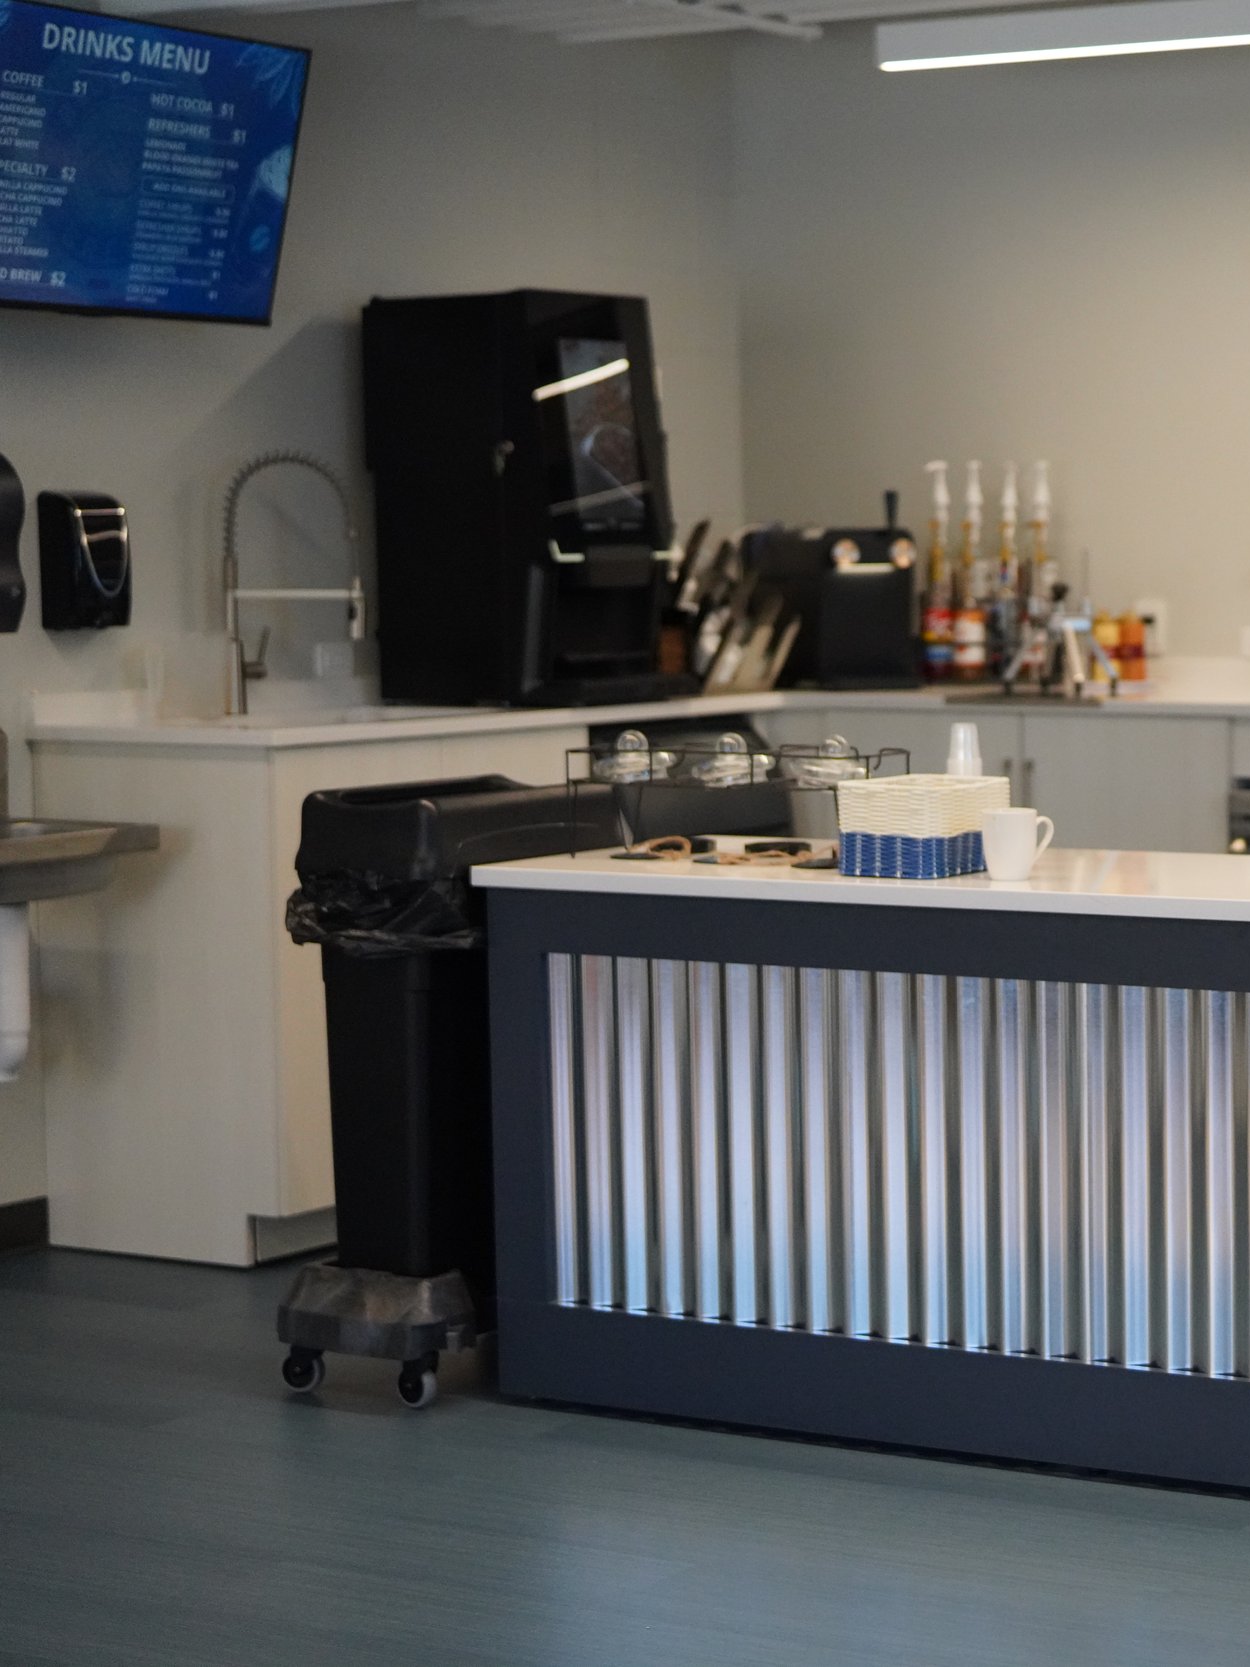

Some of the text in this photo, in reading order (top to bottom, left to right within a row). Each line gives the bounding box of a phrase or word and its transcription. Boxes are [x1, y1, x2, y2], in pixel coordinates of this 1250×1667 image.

[42, 22, 211, 75] DRINKS MENU
[2, 70, 88, 95] COFFEE $1
[151, 93, 235, 119] HOT COCOA $1
[0, 126, 19, 136] ATTE
[148, 118, 247, 145] REFRESHERS $1
[0, 159, 76, 183] PECIALTY $2
[10, 268, 43, 283] BREW
[50, 271, 66, 288] $2
